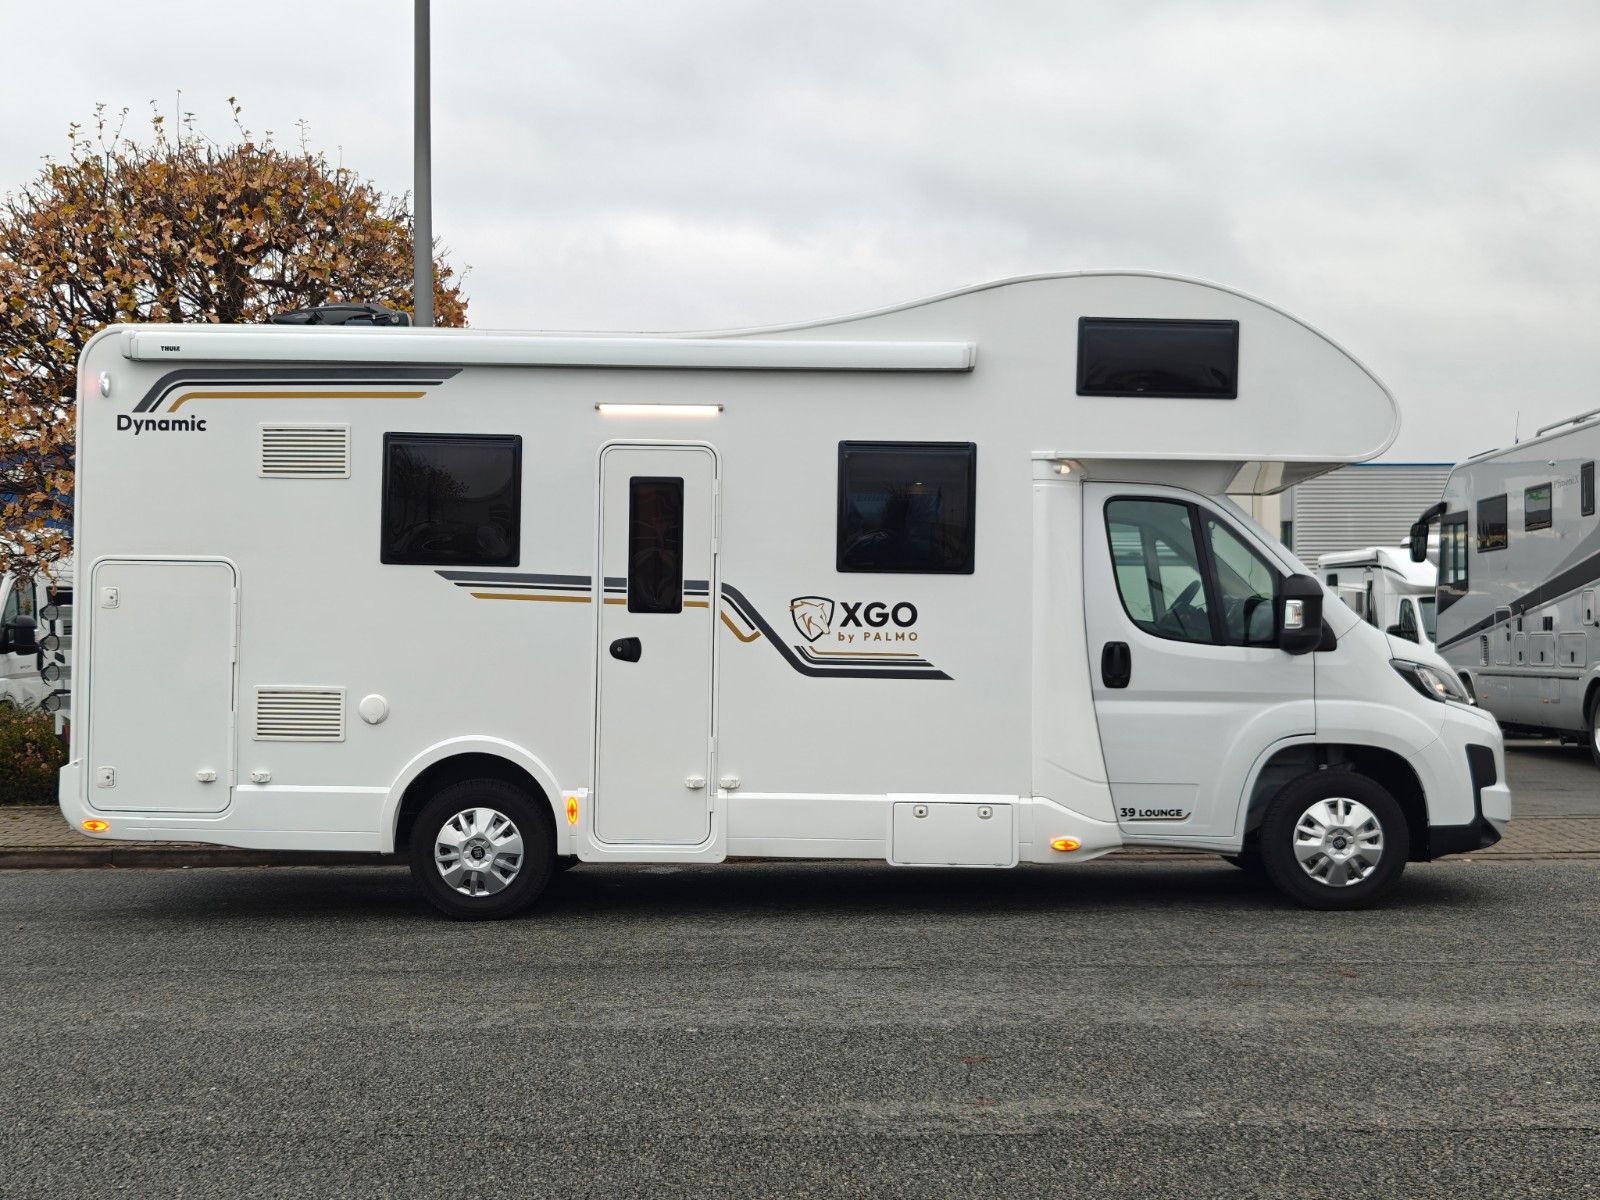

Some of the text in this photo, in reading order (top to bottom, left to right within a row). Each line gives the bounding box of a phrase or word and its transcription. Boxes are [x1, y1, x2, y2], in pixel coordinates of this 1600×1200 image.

[117, 414, 207, 435] Dynamic
[840, 601, 918, 628] XGO
[838, 632, 918, 643] by PALMO
[1120, 807, 1183, 817] 39 LOUNGE
